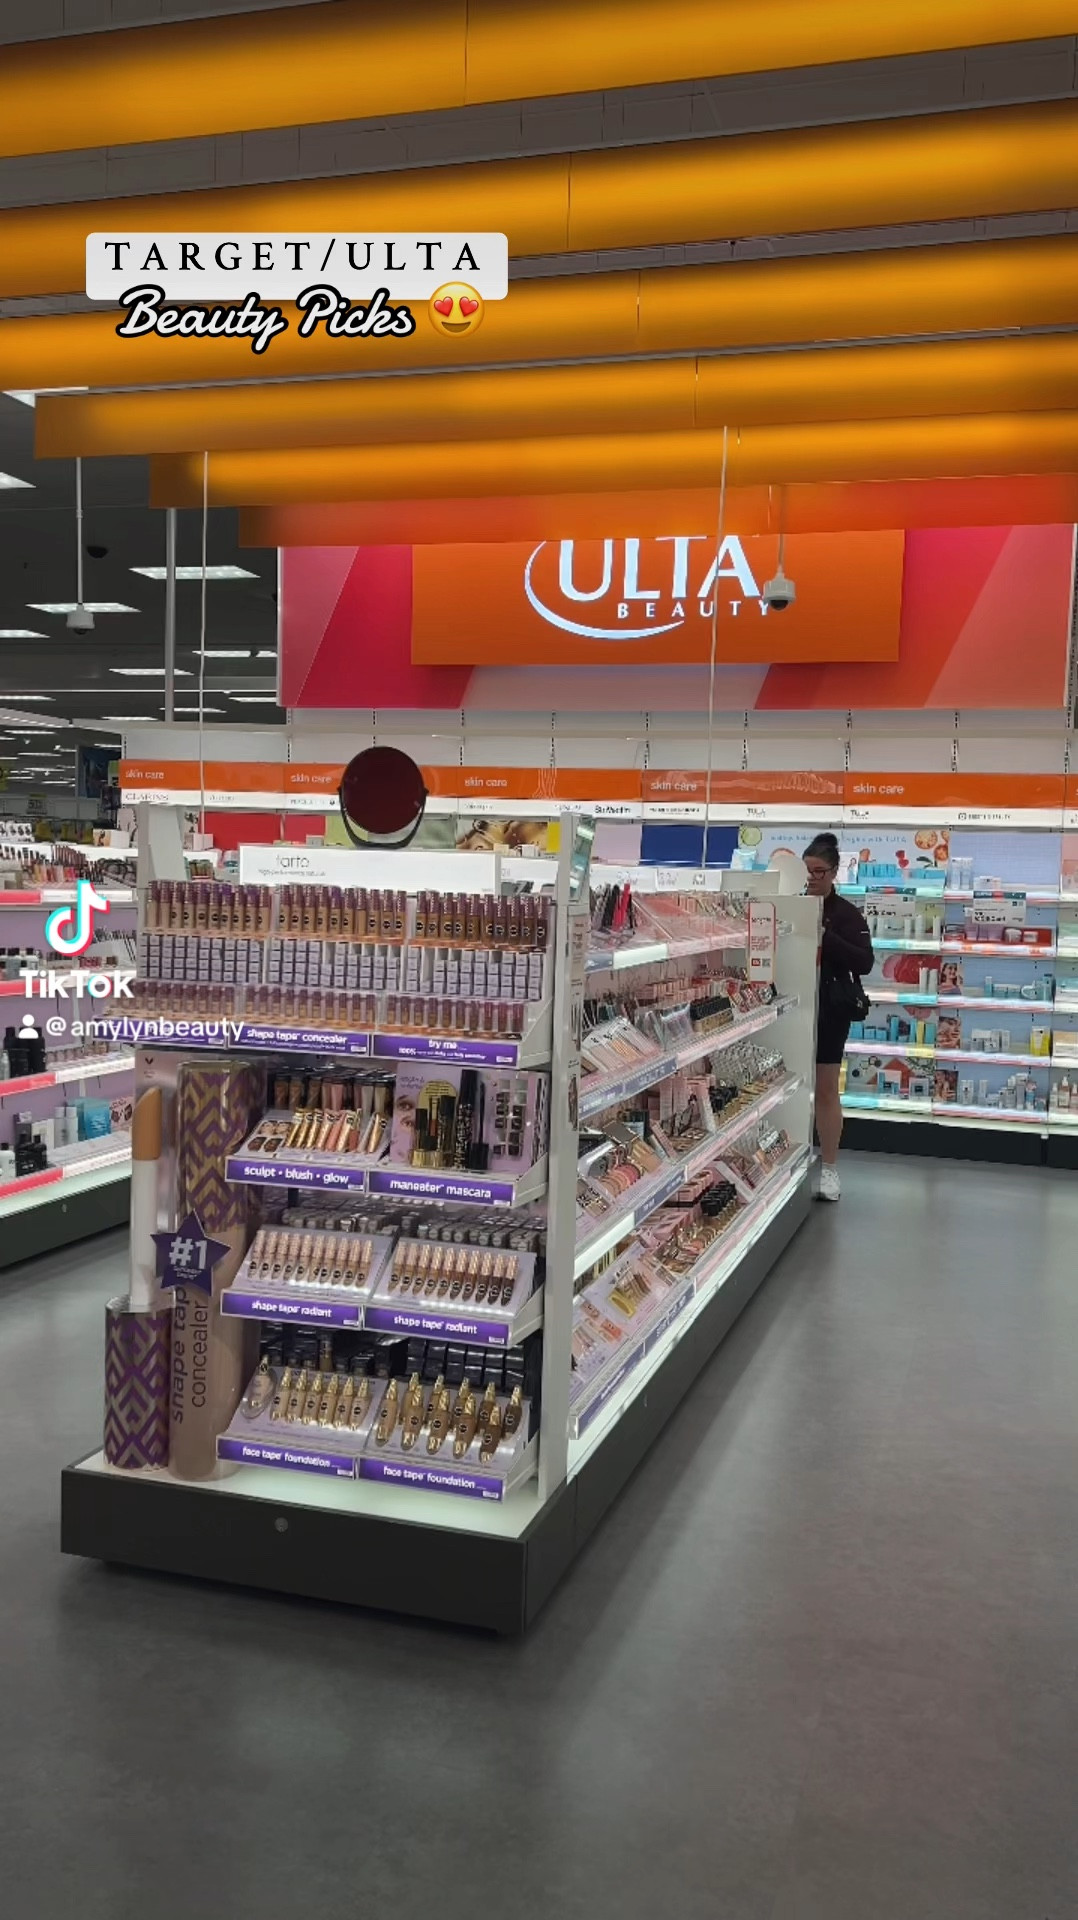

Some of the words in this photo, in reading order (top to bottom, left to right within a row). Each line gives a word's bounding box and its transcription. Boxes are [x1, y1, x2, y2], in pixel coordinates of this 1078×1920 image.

[559, 535, 761, 601] ULTA
[617, 600, 768, 619] BEAUTY
[464, 778, 483, 787] skin
[486, 779, 508, 787] care
[650, 781, 672, 791] skin
[674, 782, 697, 792] care
[853, 784, 876, 793] skin
[879, 785, 904, 795] care
[302, 1034, 348, 1044] concealer
[428, 1039, 442, 1049] try
[443, 1041, 457, 1050] me
[244, 1166, 276, 1179] sculpt
[285, 1168, 313, 1181] blush
[323, 1172, 349, 1185] glow
[389, 1179, 442, 1193] maneater
[446, 1187, 492, 1198] mascara
[169, 1237, 208, 1270] #1
[173, 1285, 190, 1331] tap
[251, 1301, 277, 1315] shape
[301, 1306, 332, 1318] radiant
[393, 1316, 420, 1330] shape
[422, 1319, 442, 1332] tape
[445, 1322, 478, 1334] radiant
[190, 1300, 209, 1408] concealer
[242, 1447, 261, 1457] face
[262, 1450, 281, 1461] tape
[284, 1452, 331, 1467] foundation
[383, 1466, 402, 1477] face
[403, 1470, 423, 1482] tape
[426, 1472, 476, 1489] foundation
